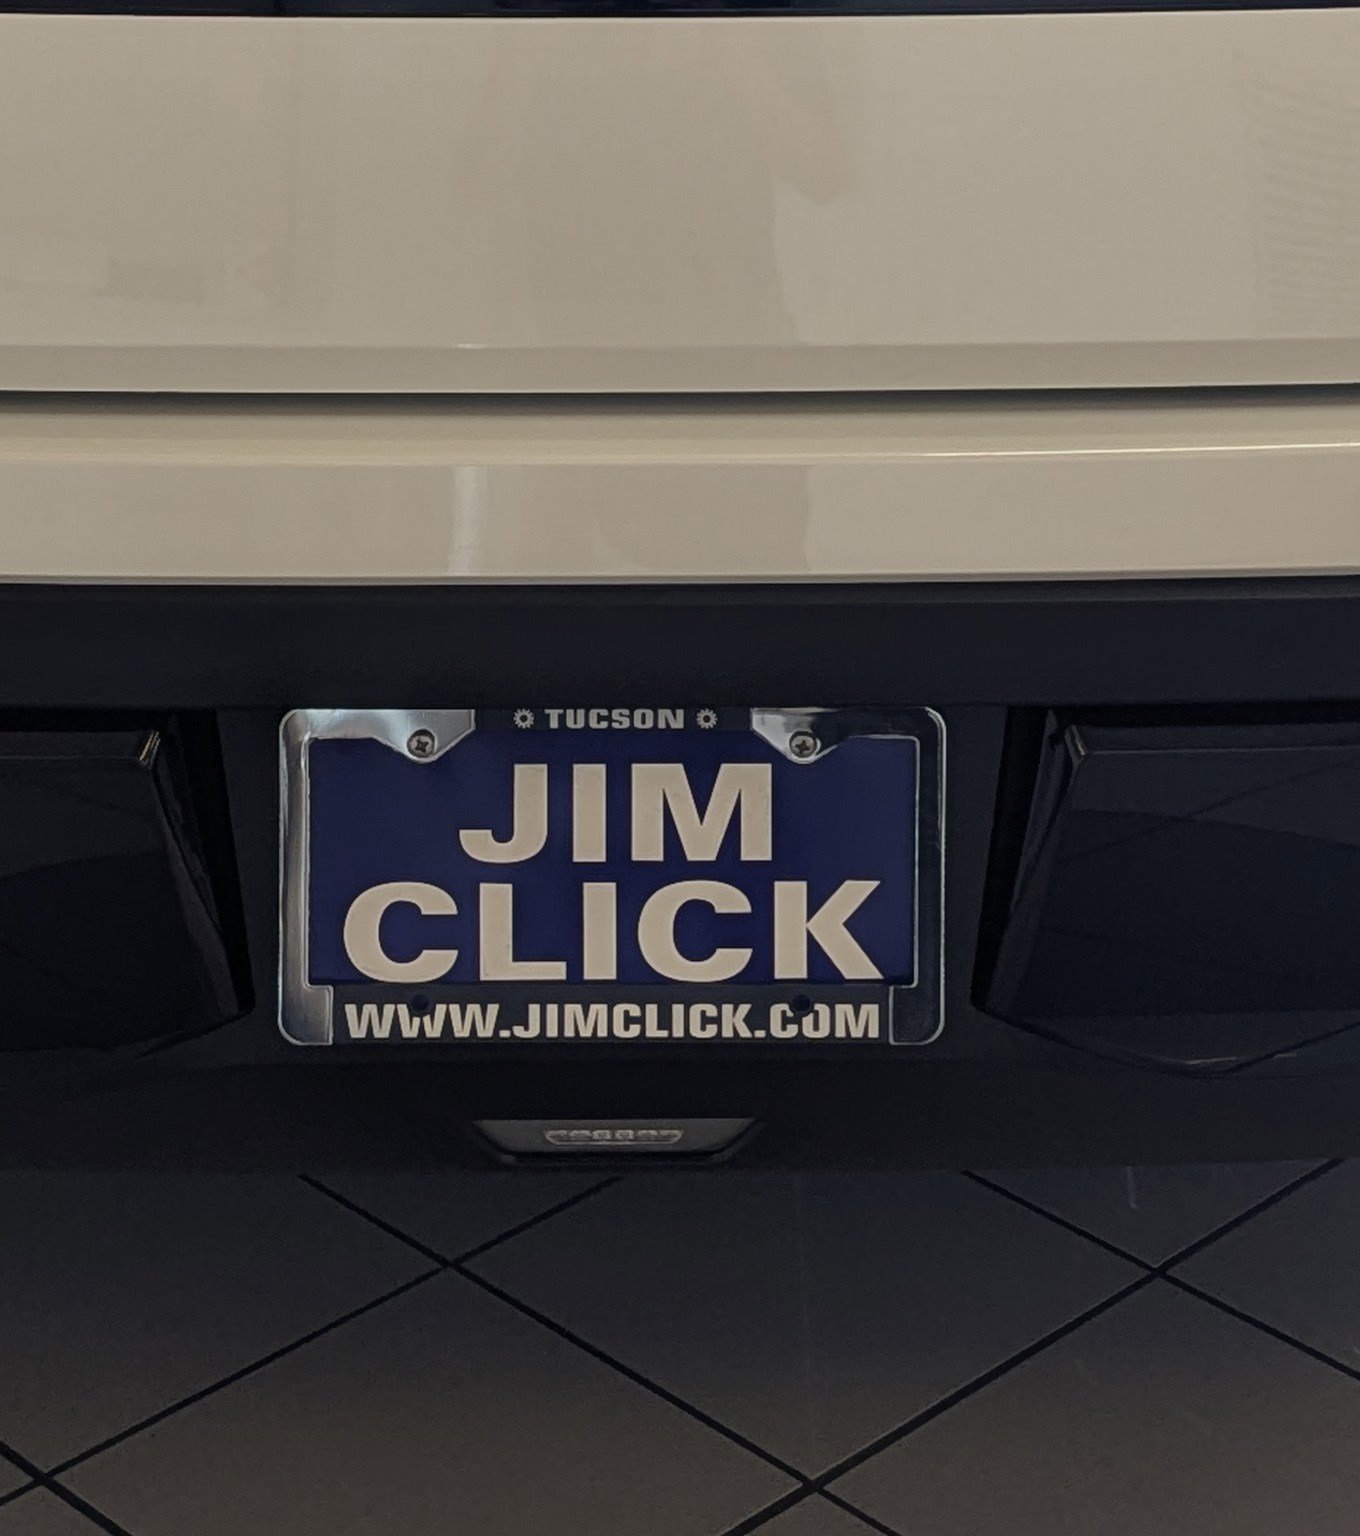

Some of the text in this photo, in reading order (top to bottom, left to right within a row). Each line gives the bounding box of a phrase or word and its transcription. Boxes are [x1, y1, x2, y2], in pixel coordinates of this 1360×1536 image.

[544, 707, 686, 730] TUCSON
[458, 762, 773, 864] JIM
[343, 879, 884, 983] CLICK
[344, 1002, 881, 1039] WWW.JIMCLICK.COM
